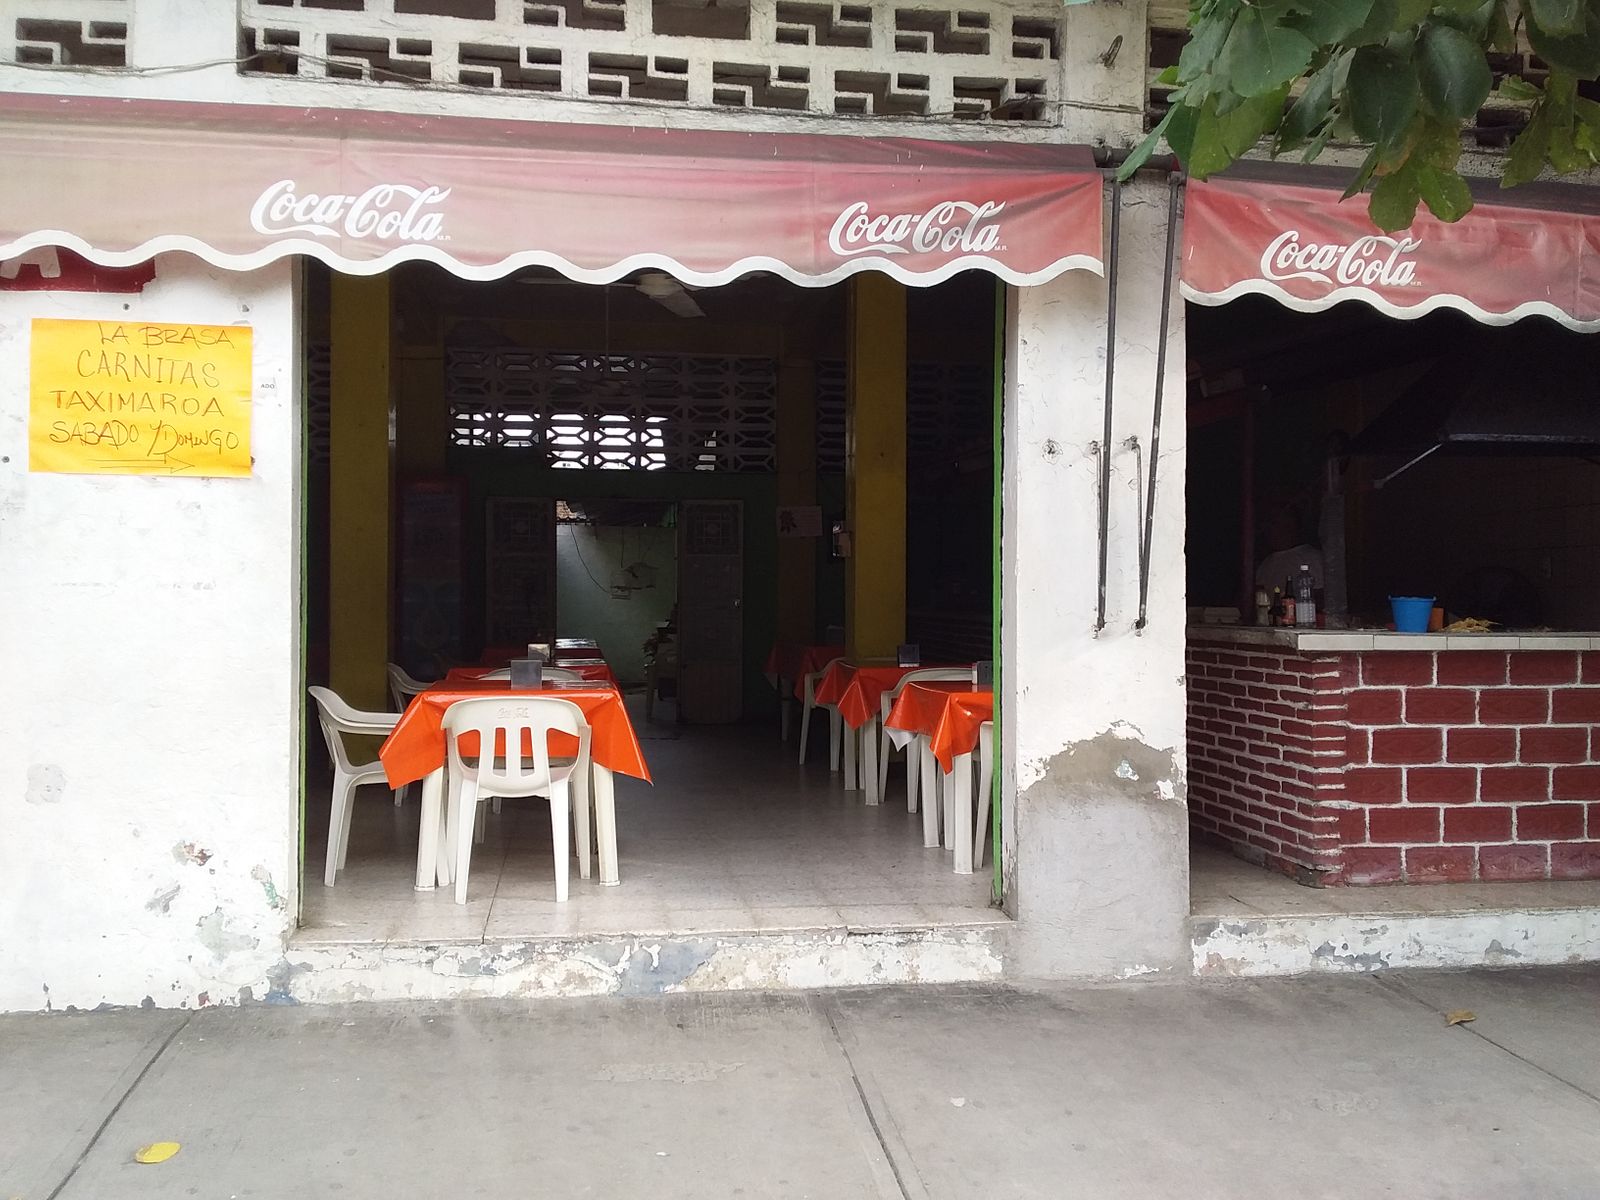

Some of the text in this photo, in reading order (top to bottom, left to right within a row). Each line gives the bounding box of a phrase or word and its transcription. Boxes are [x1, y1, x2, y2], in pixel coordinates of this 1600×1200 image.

[250, 179, 452, 241] Coca-Cola
[828, 200, 1006, 256] Coca-Cola
[1260, 230, 1423, 287] Coca-Cola
[98, 322, 235, 349] LA BRASA
[77, 349, 220, 389] CARNITAS
[50, 390, 225, 417] TAXIMAROA
[49, 419, 140, 450] SABADO
